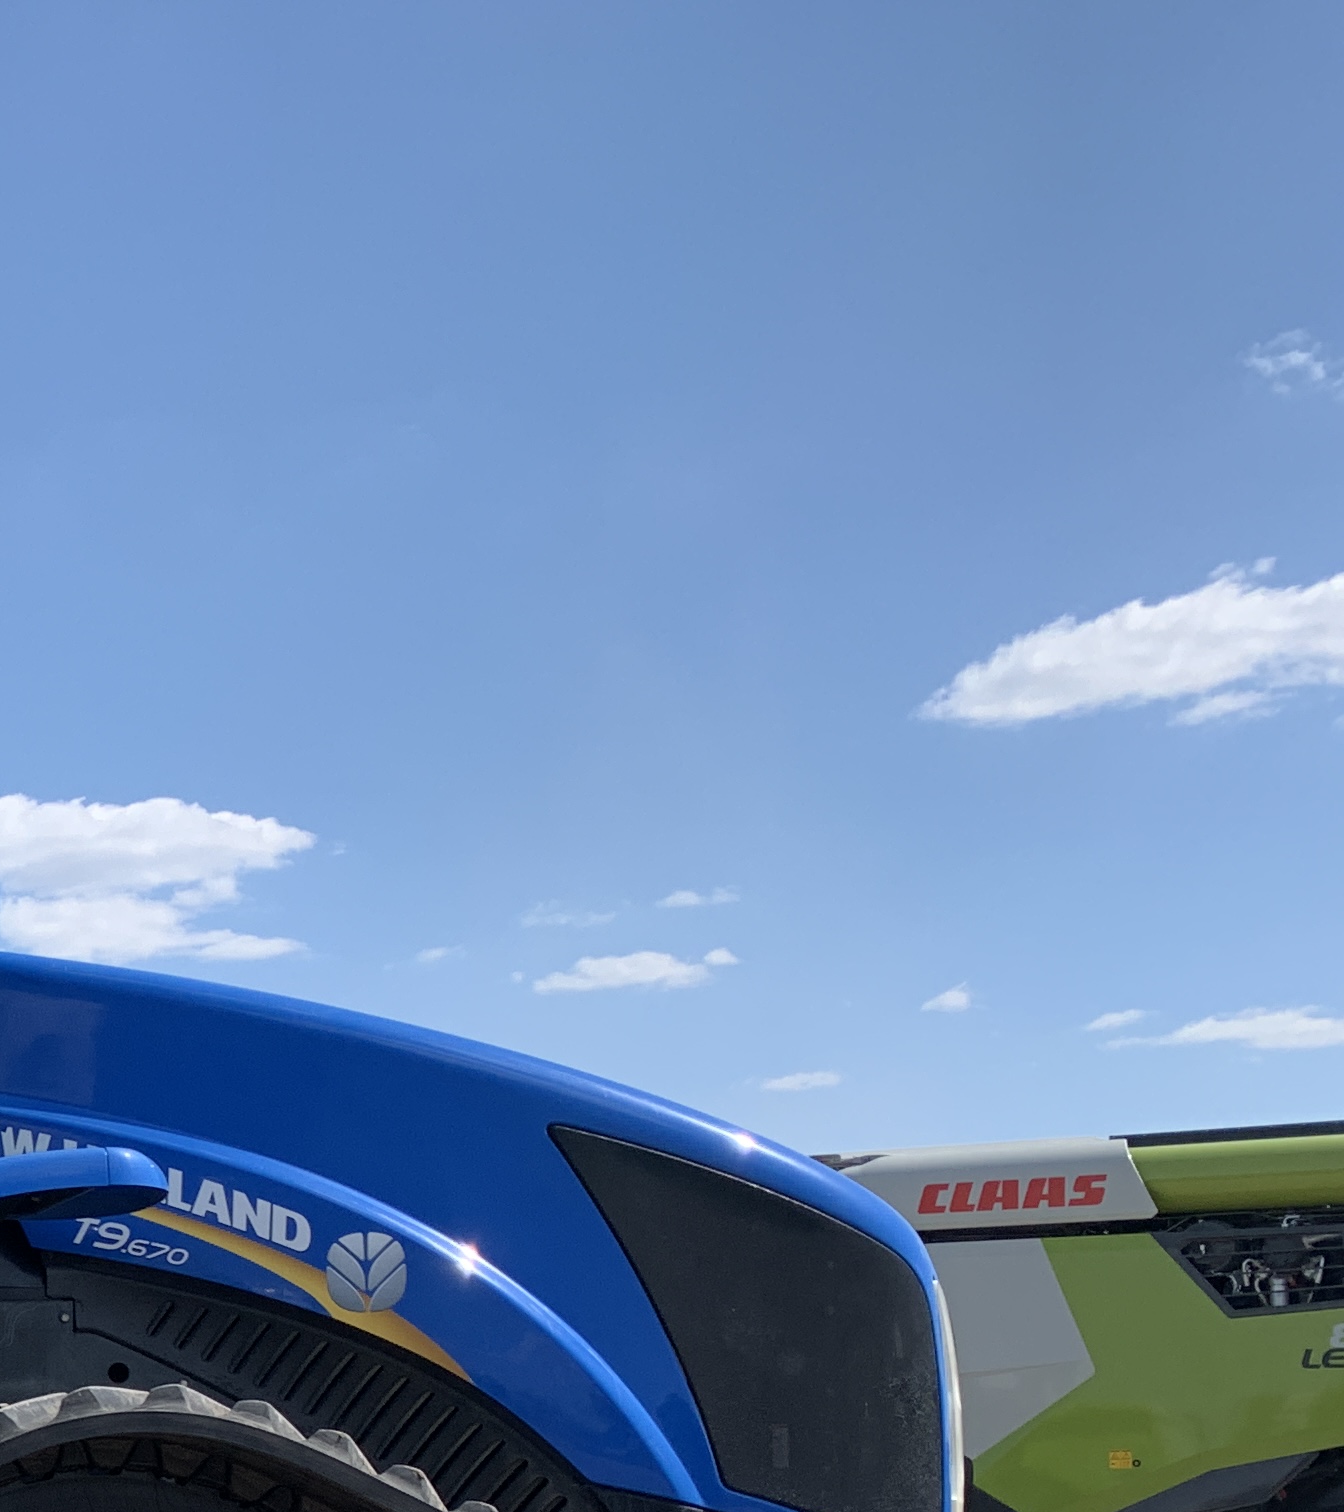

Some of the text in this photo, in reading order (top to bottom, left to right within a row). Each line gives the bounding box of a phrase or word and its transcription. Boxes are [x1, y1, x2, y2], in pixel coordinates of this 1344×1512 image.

[63, 1139, 312, 1252] LAND
[917, 1174, 1108, 1215] CLAAS
[72, 1217, 190, 1266] T9.670
